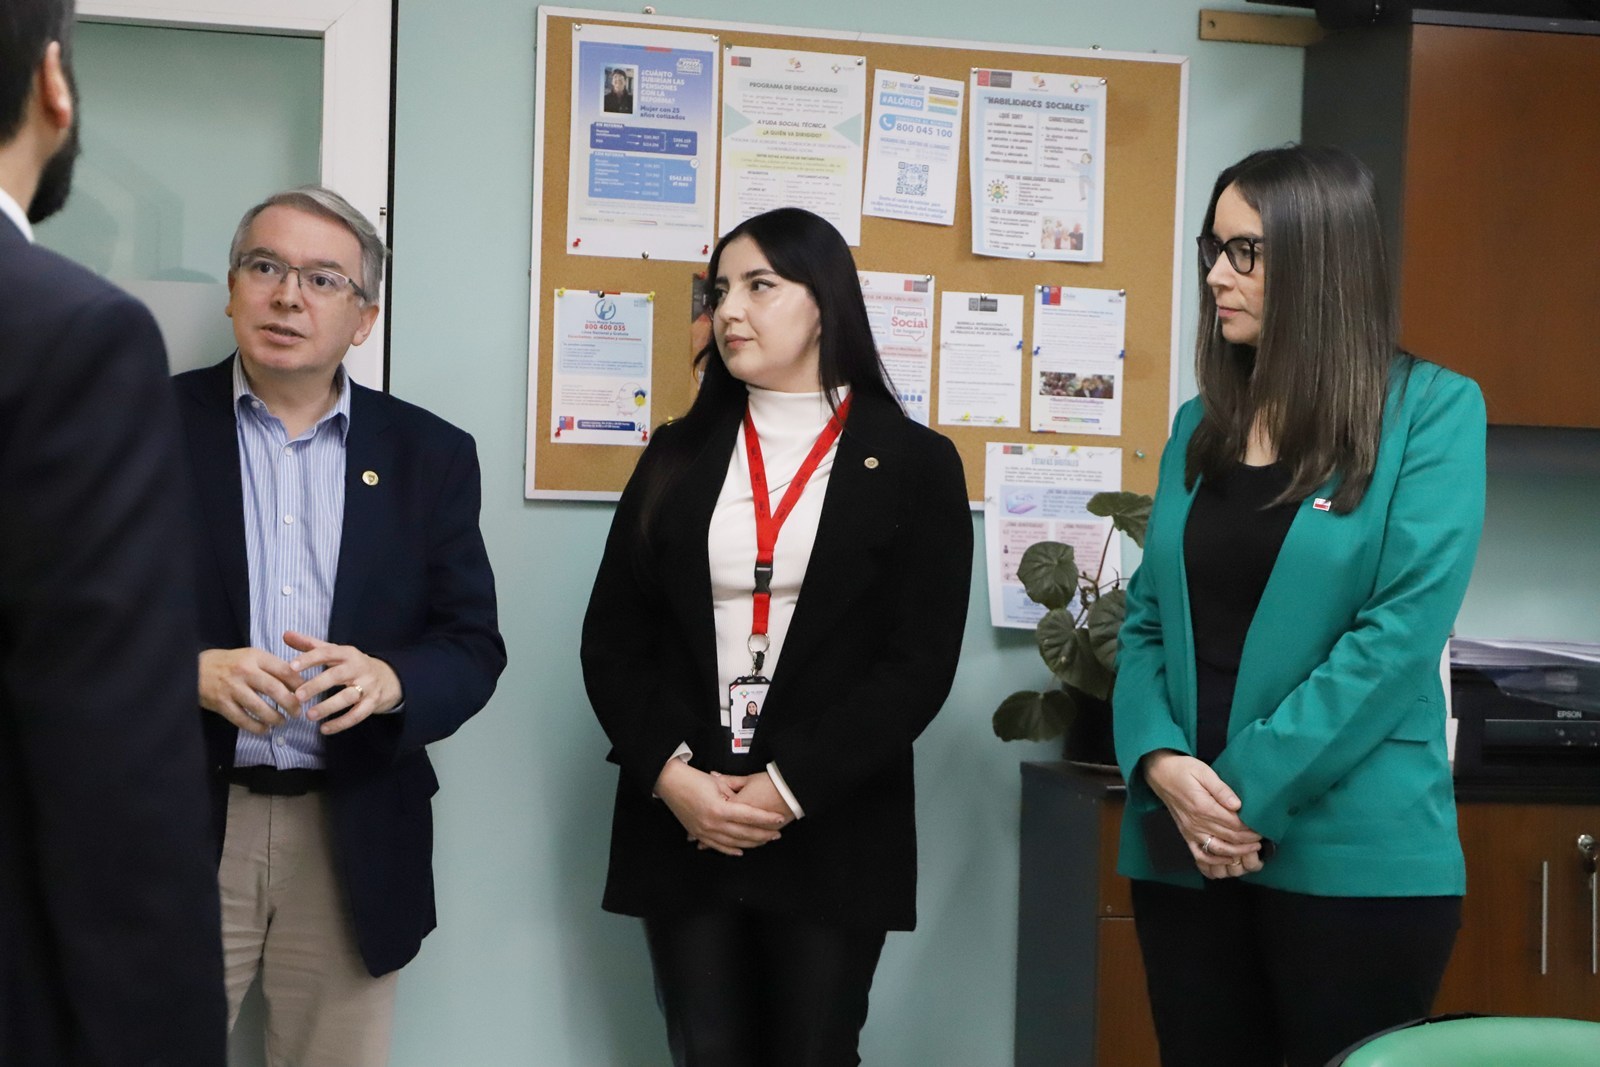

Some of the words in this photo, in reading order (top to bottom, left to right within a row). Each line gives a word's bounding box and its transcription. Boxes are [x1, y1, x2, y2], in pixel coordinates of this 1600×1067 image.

[641, 69, 673, 77] ¿CUÁNTO
[641, 83, 678, 91] PENSIONES
[749, 82, 783, 90] PROGRAMA
[793, 85, 838, 93] DISCAPACIDAD
[640, 105, 659, 113] Mujer
[656, 112, 686, 120] cotizados
[896, 123, 914, 132] 800
[916, 125, 933, 134] 045
[937, 128, 952, 137] 100
[891, 316, 928, 328] Social
[1556, 710, 1582, 718] EPSON
